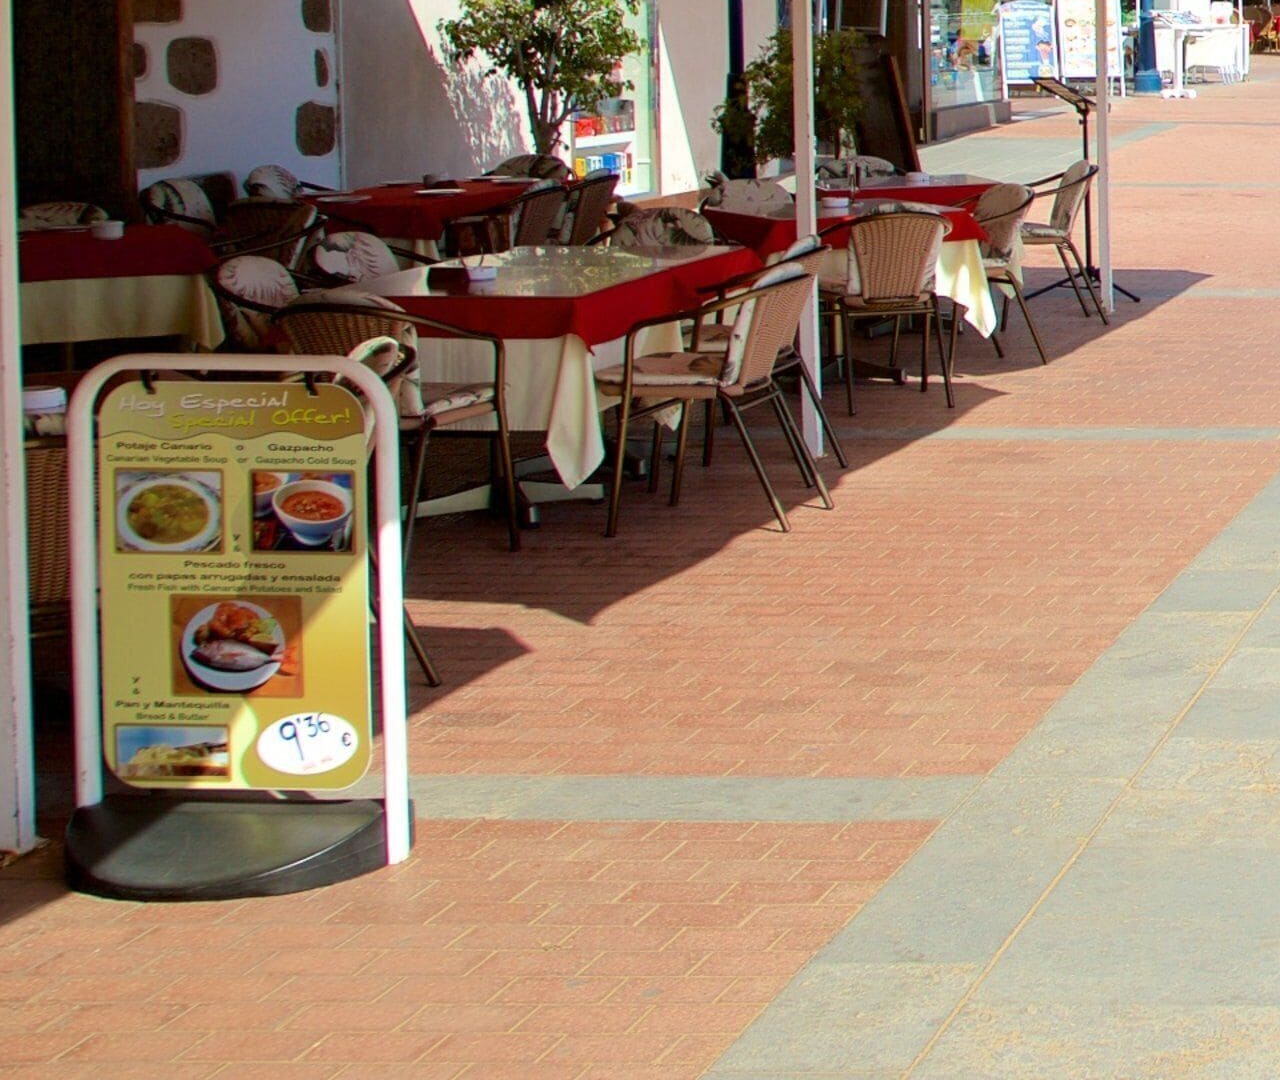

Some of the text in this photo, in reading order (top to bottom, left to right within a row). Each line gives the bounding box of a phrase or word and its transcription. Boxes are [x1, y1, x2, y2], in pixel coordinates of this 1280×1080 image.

[119, 391, 289, 418] Hoy Especial
[172, 408, 350, 434] Special Offer!
[116, 441, 212, 452] Potaje Canario
[267, 443, 334, 453] Gazpacho
[202, 456, 228, 464] Soup
[255, 456, 305, 465] Gazpacho
[332, 457, 357, 465] Soup
[184, 560, 286, 569] Pescado fresco
[156, 573, 196, 581] papas
[200, 574, 267, 582] arrugadas
[281, 574, 341, 582] ensalada
[154, 701, 230, 709] Mantequilla
